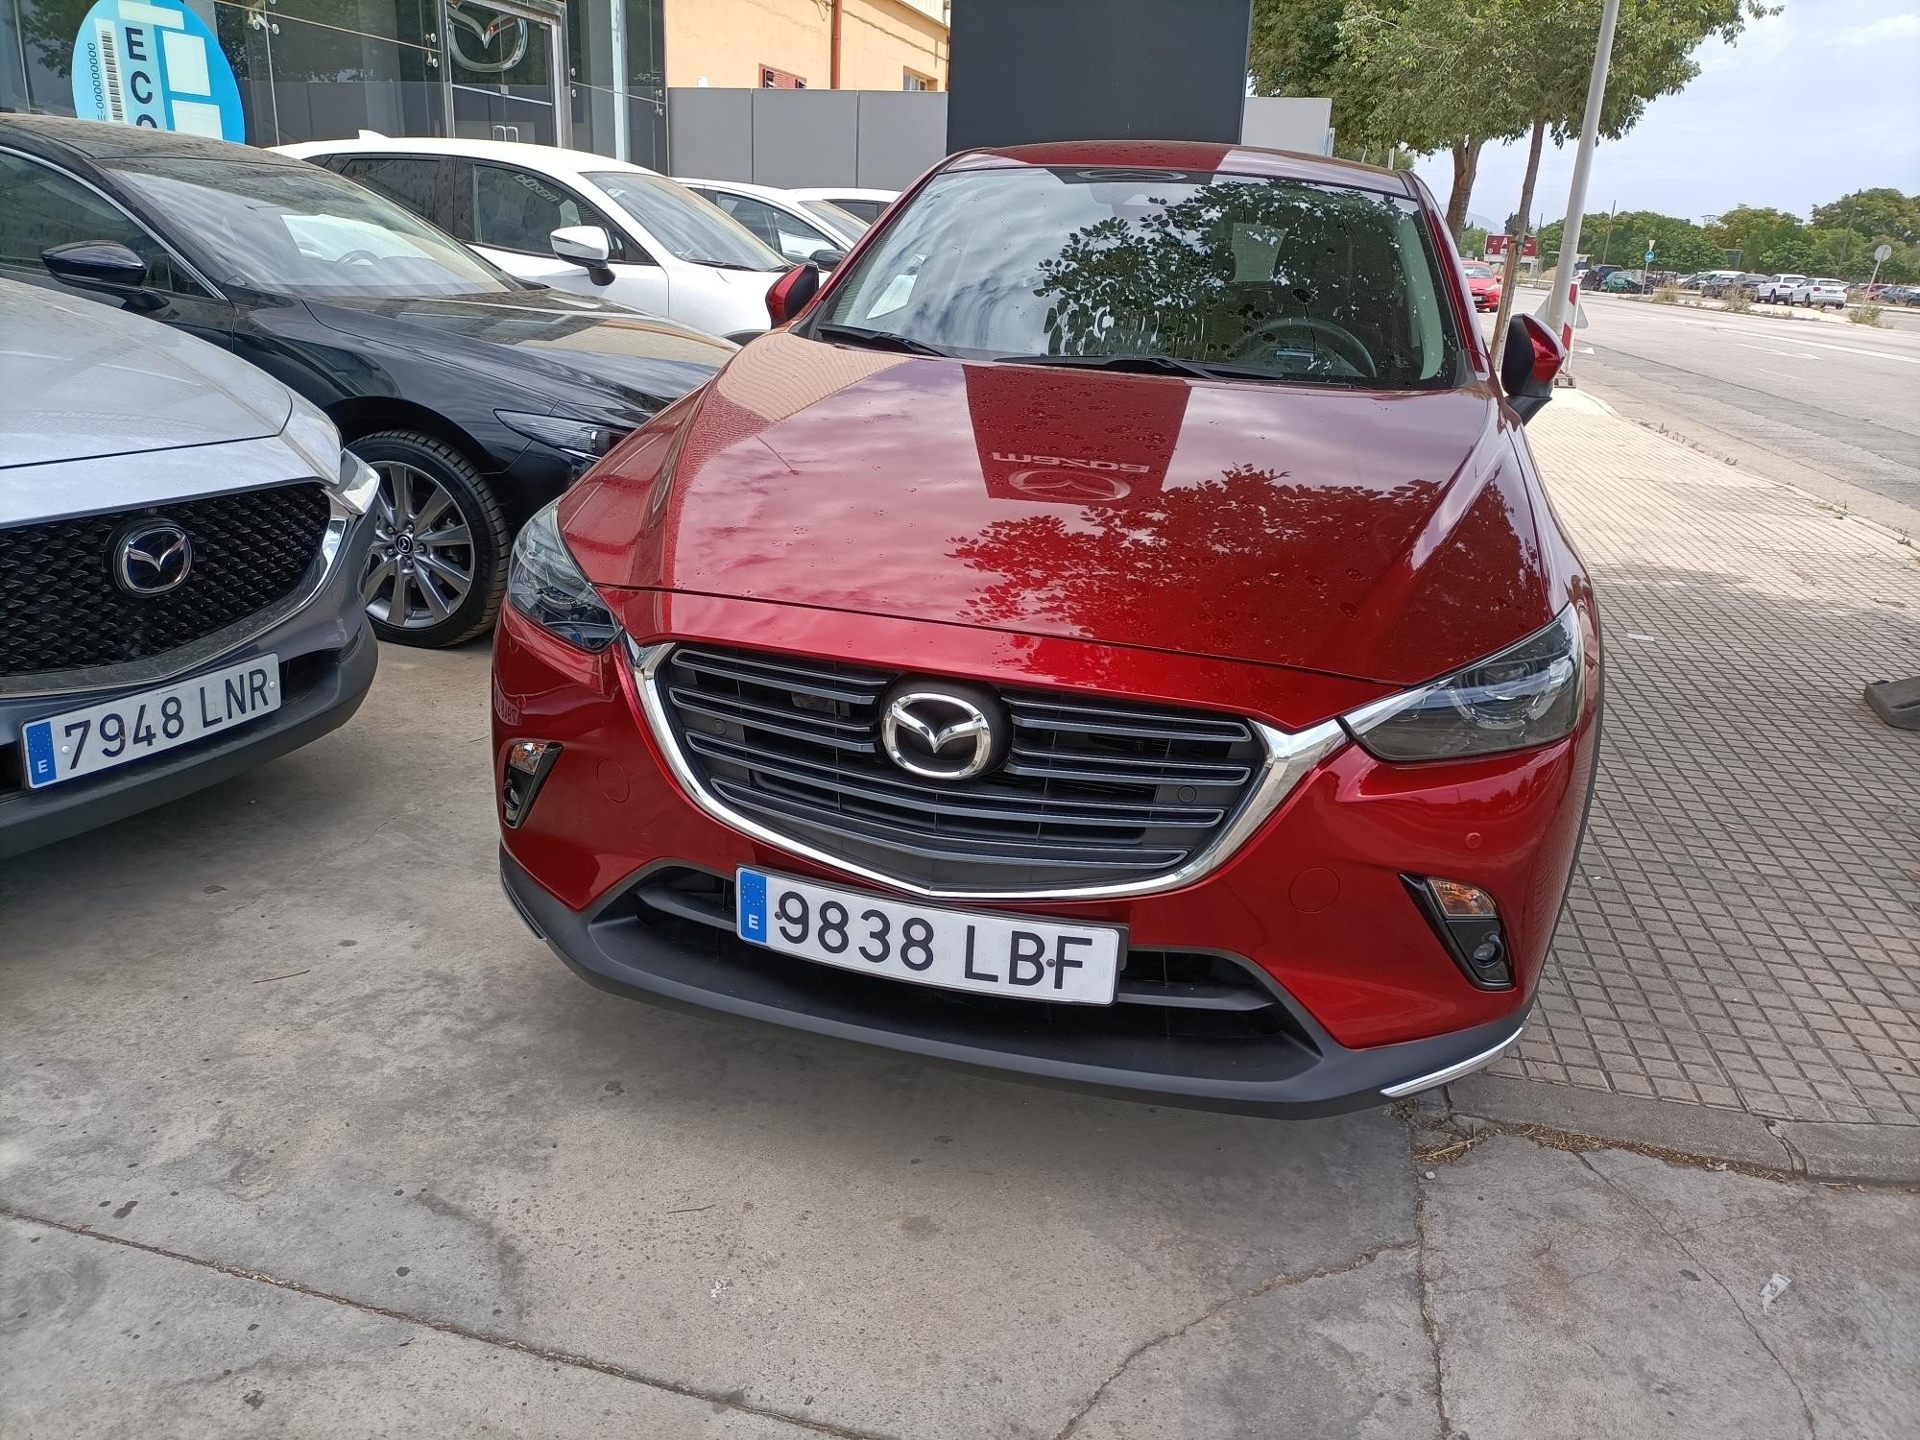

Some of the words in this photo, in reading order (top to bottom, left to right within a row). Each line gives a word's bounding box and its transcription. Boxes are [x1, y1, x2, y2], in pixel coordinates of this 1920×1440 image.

[64, 696, 185, 770] 7948
[199, 668, 270, 729] LNR
[37, 758, 49, 774] E
[747, 914, 760, 930] E
[778, 890, 935, 972] 9838
[963, 924, 1094, 990] LBF
